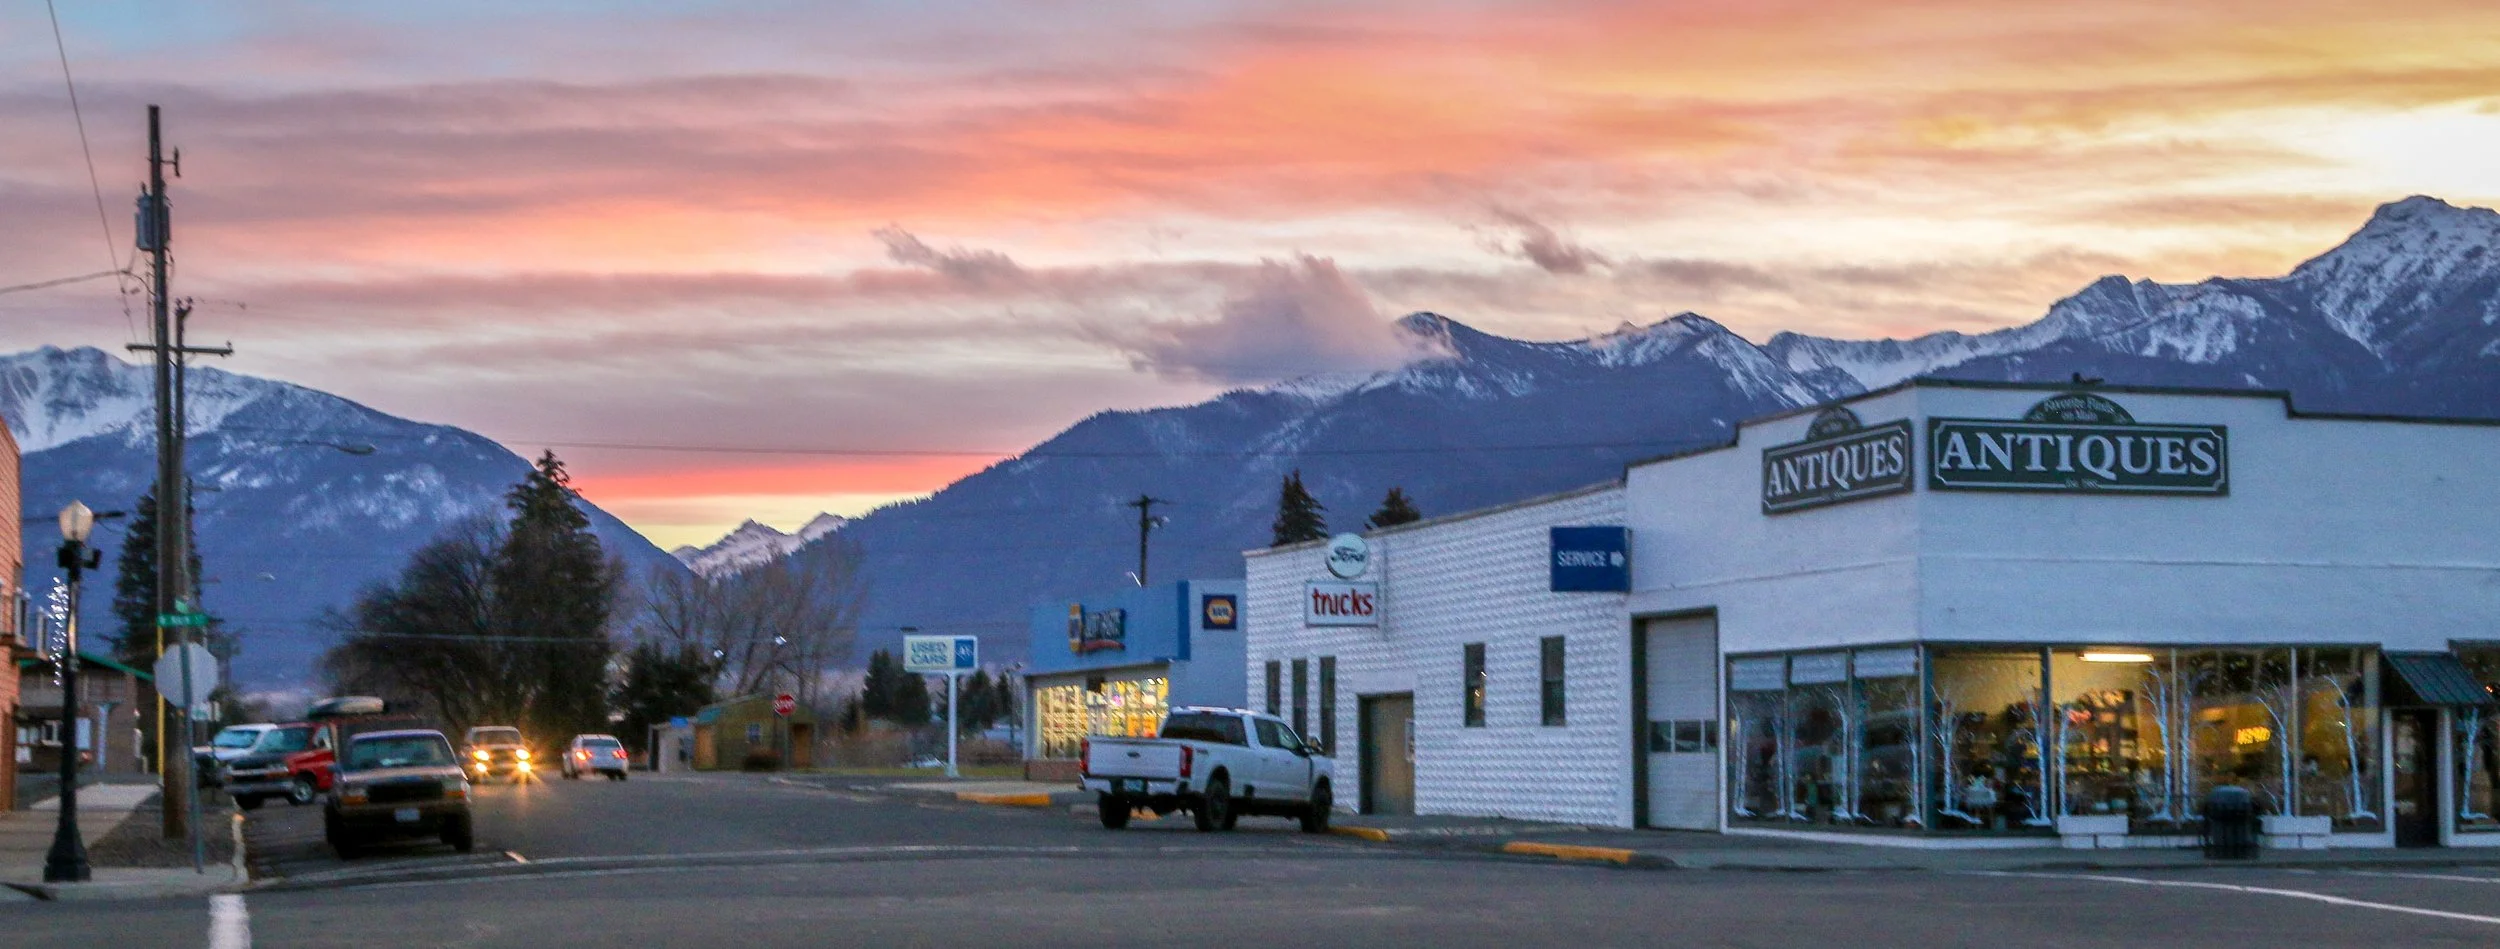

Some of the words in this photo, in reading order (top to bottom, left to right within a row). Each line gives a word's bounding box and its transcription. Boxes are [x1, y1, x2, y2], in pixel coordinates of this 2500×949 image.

[1939, 432, 2217, 481] ANTIQUES
[1767, 436, 1904, 497] ANTIQUES
[1330, 546, 1366, 561] Ford
[1557, 550, 1607, 567] SERVICE
[1312, 587, 1373, 616] trucks
[911, 641, 947, 653] USED
[911, 653, 947, 665] CARS
